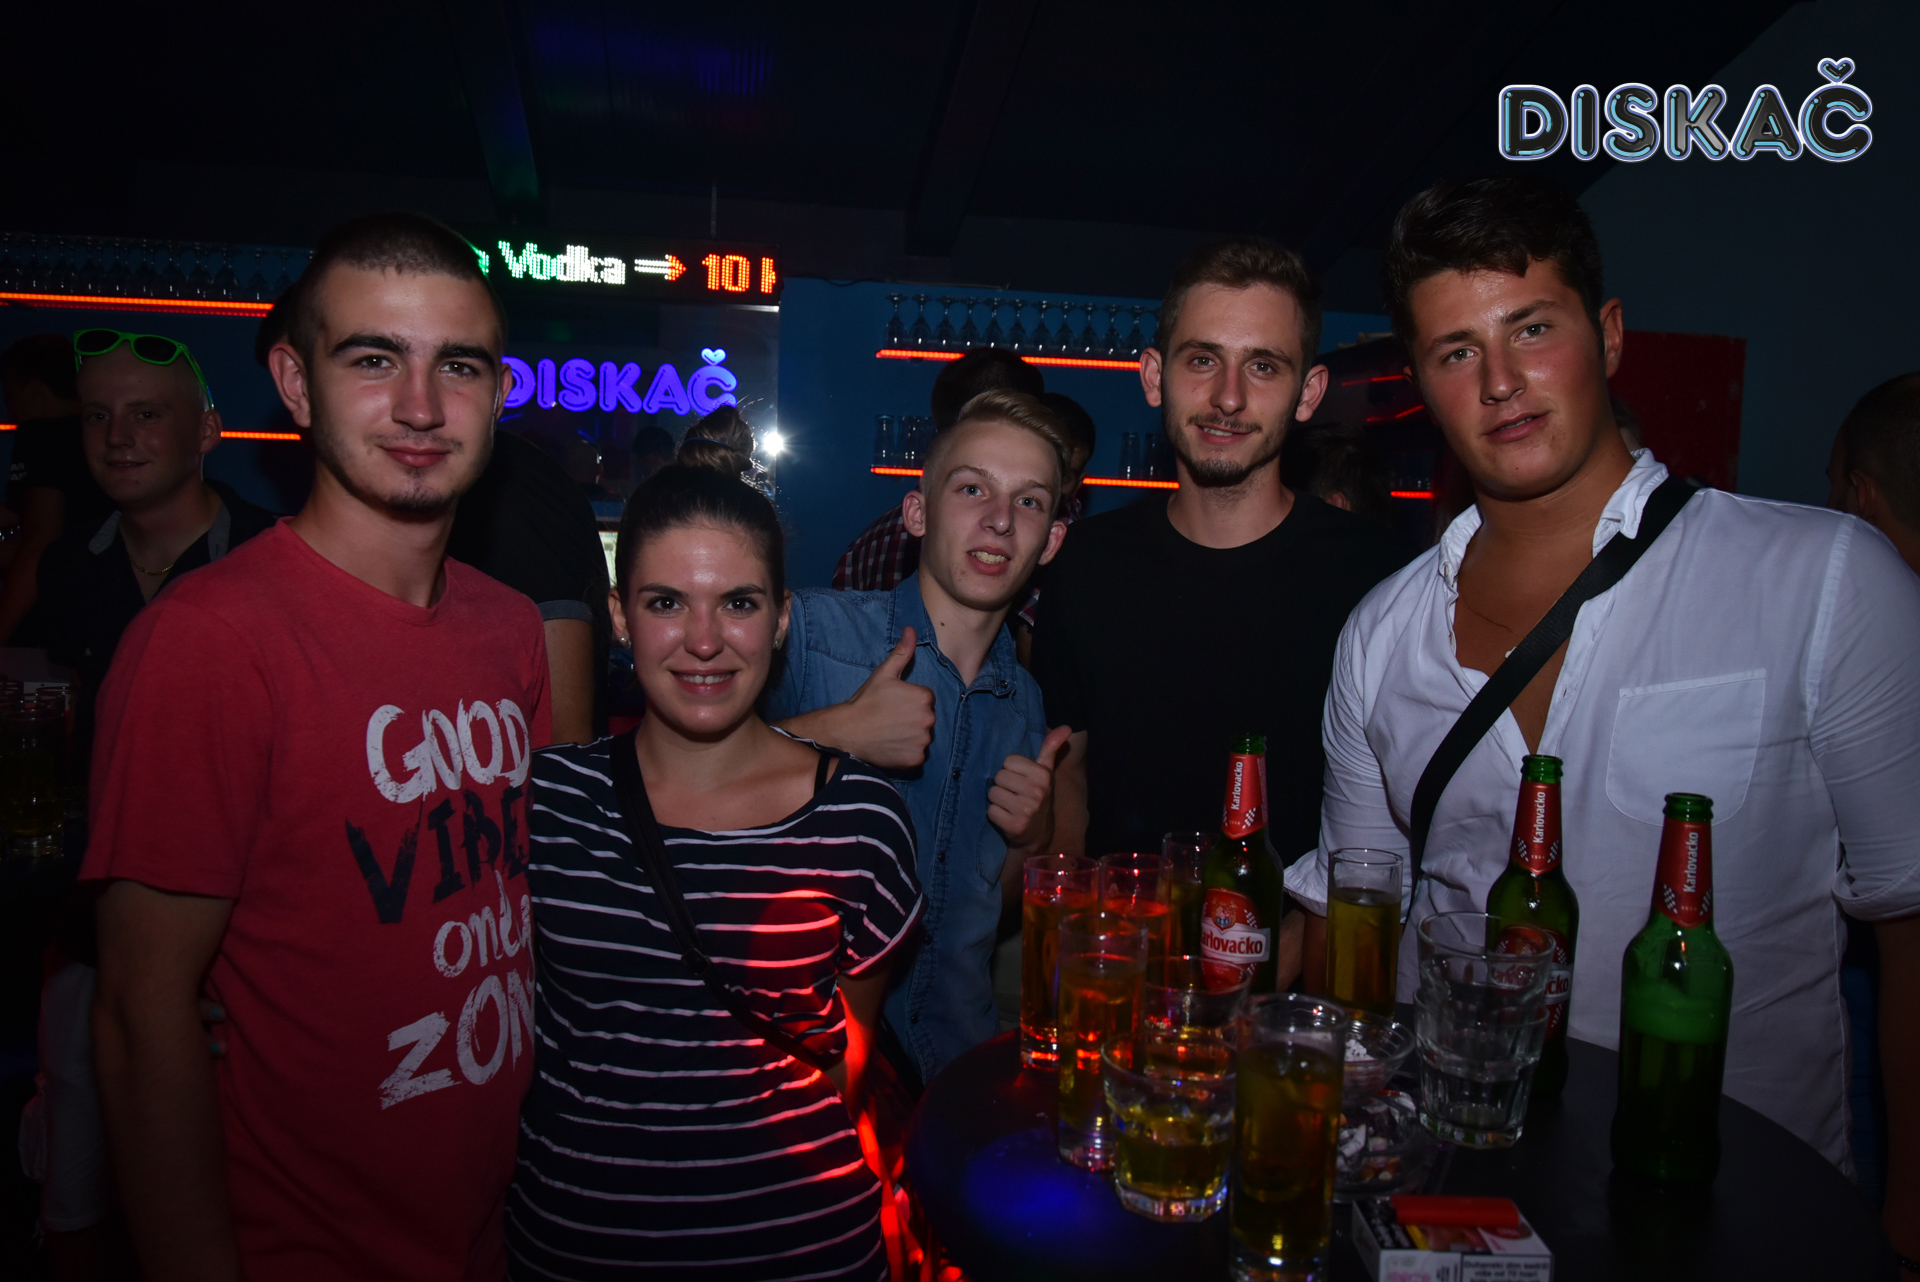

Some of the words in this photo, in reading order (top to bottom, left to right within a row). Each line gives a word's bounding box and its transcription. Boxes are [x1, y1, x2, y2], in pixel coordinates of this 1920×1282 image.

[498, 241, 626, 285] Vodka
[702, 253, 750, 293] 10
[366, 698, 530, 803] GOOD
[345, 786, 533, 924] VIBE
[1202, 931, 1263, 954] arlovačko
[378, 968, 536, 1110] ZON
